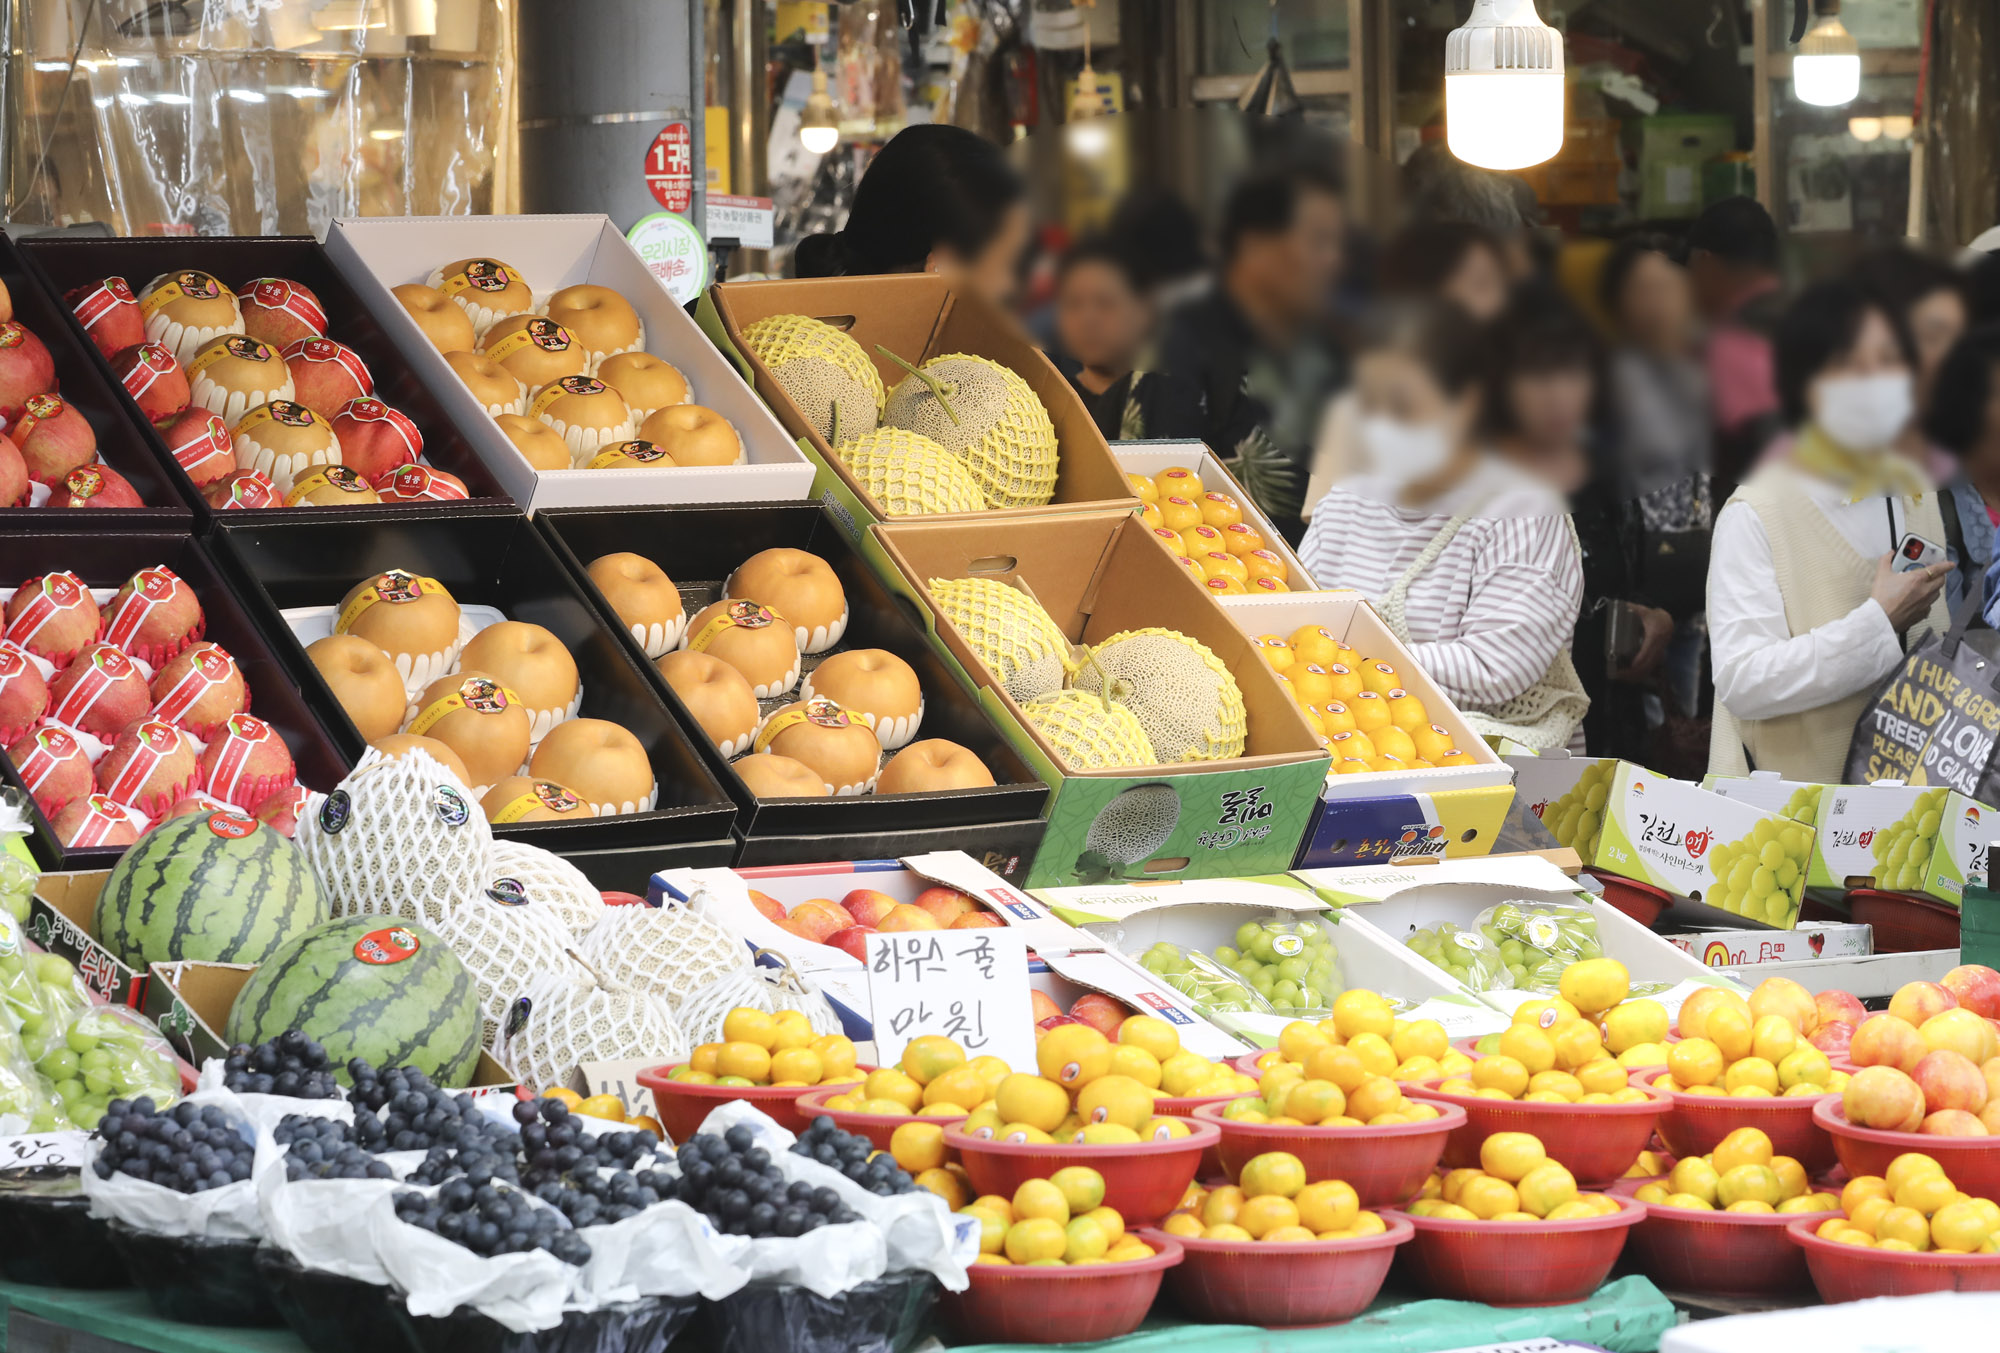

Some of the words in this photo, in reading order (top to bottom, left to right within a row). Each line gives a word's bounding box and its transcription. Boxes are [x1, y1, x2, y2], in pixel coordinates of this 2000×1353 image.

[641, 234, 690, 261] 우리시장
[265, 284, 281, 296] 명품
[313, 342, 330, 352] 명품
[361, 403, 378, 412] 명품
[404, 474, 421, 485] 명품
[54, 581, 71, 595] 명품
[146, 576, 163, 590] 명품
[105, 653, 121, 667] 명품
[204, 655, 220, 669] 명품
[1919, 660, 1961, 700] HUE
[1953, 687, 1971, 709] &
[1880, 678, 1940, 726] AND
[1874, 708, 1927, 751] TREES
[1873, 733, 1917, 772] PLEASE
[1941, 715, 1993, 772] LOVE
[1218, 786, 1272, 824] 멜론
[1639, 813, 1677, 843] 김천
[1832, 829, 1854, 848] 김천
[873, 937, 948, 983] 하우스
